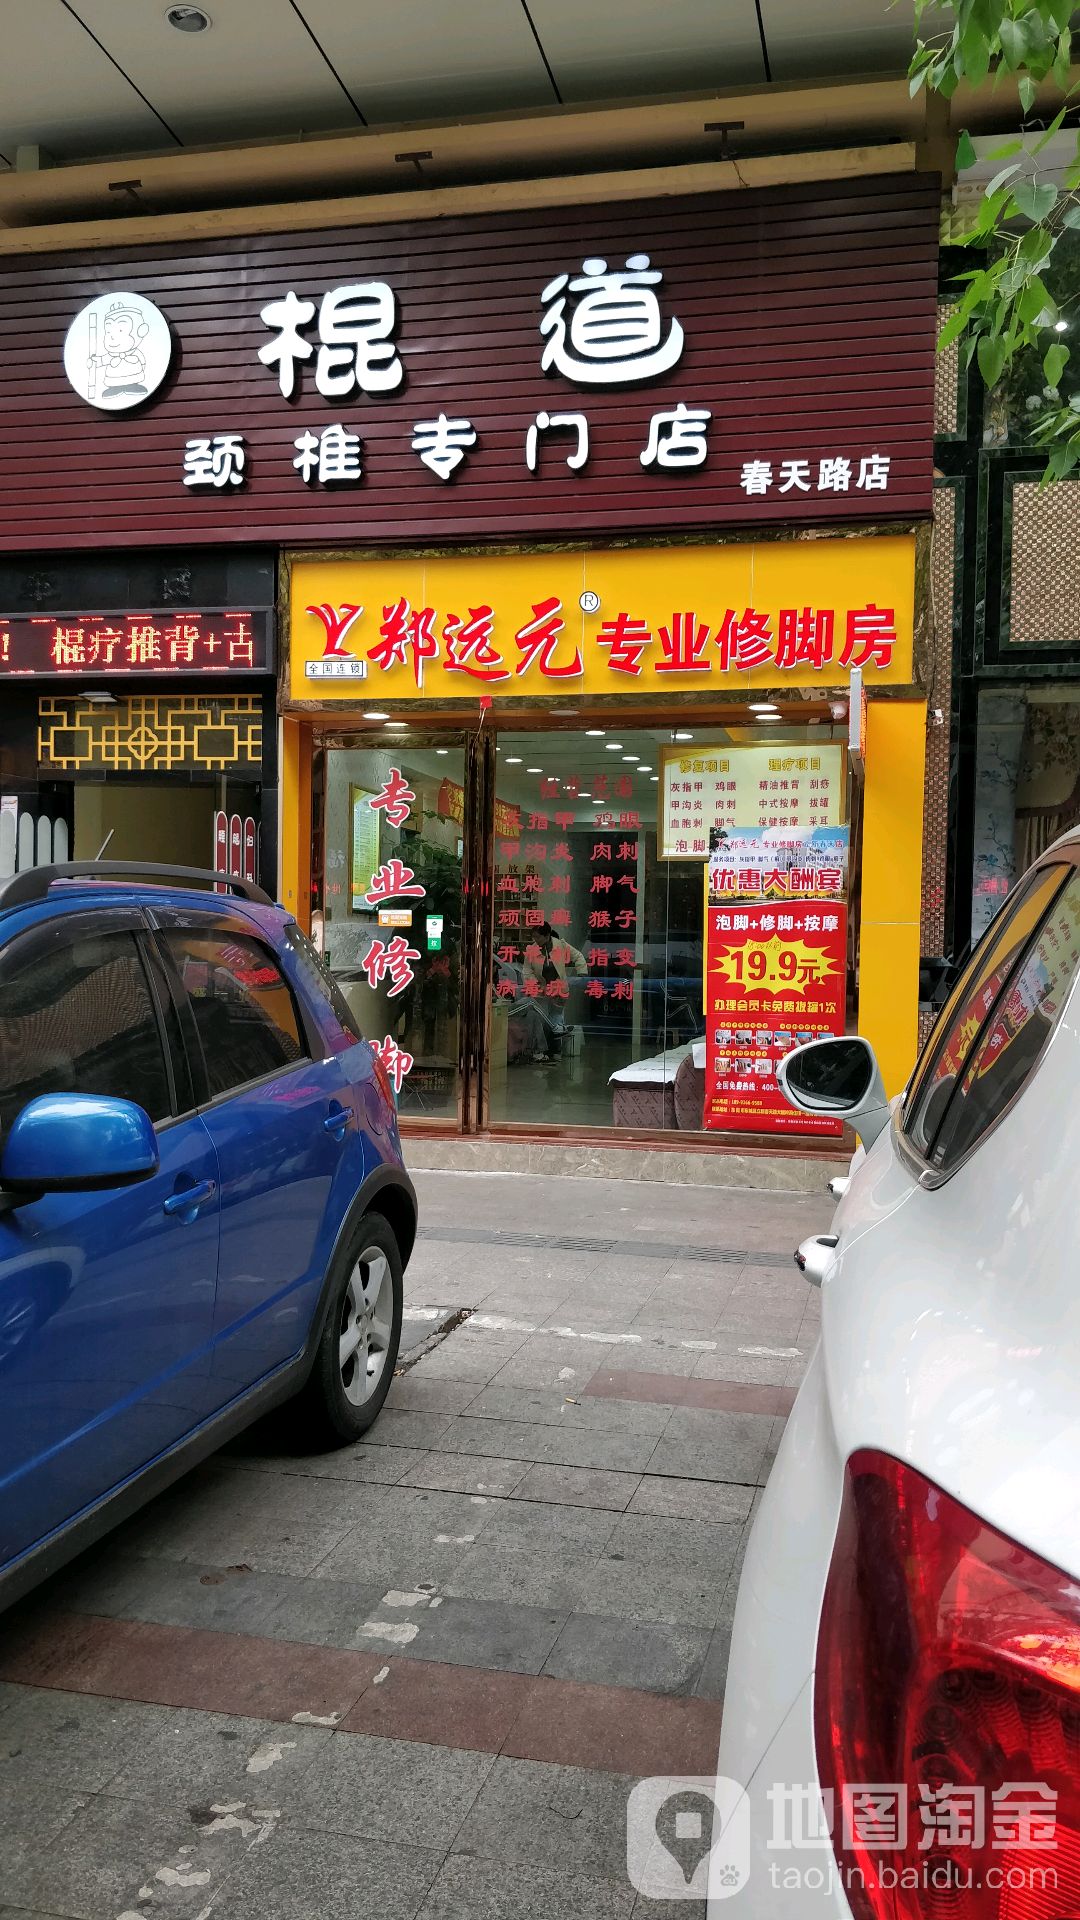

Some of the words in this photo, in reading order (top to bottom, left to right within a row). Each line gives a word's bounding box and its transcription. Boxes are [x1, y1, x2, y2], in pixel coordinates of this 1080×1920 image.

[257, 254, 685, 398] 棍道
[740, 454, 891, 496] 春天路店
[366, 596, 584, 689] 郑远元
[596, 604, 898, 677] 专业修脚房
[308, 662, 361, 676] 全国连锁
[768, 757, 822, 772] 理疗项目
[670, 781, 704, 793] 灰指甲
[715, 781, 737, 792] 鸡眼
[759, 779, 800, 790] 精油推背
[670, 799, 703, 811] 甲沟炎
[715, 799, 736, 810] 肉刺
[758, 798, 799, 809] 中式按摩
[809, 797, 829, 809] 拔罐
[592, 811, 644, 830] 鸡眼
[714, 817, 737, 829] 脚气
[758, 817, 800, 828] 保健按摩
[808, 816, 829, 827] 采耳
[590, 841, 641, 862] 肉刺
[675, 839, 706, 854] 泡脚
[589, 874, 641, 894] 脚气
[711, 866, 842, 892] 优惠大酬宾
[587, 909, 638, 929] 猴子
[715, 914, 839, 932] 泡脚+修脚+按摩
[362, 767, 426, 1095] 专业修脚
[730, 950, 821, 984] 19.9元
[583, 980, 635, 1001] 毒刺
